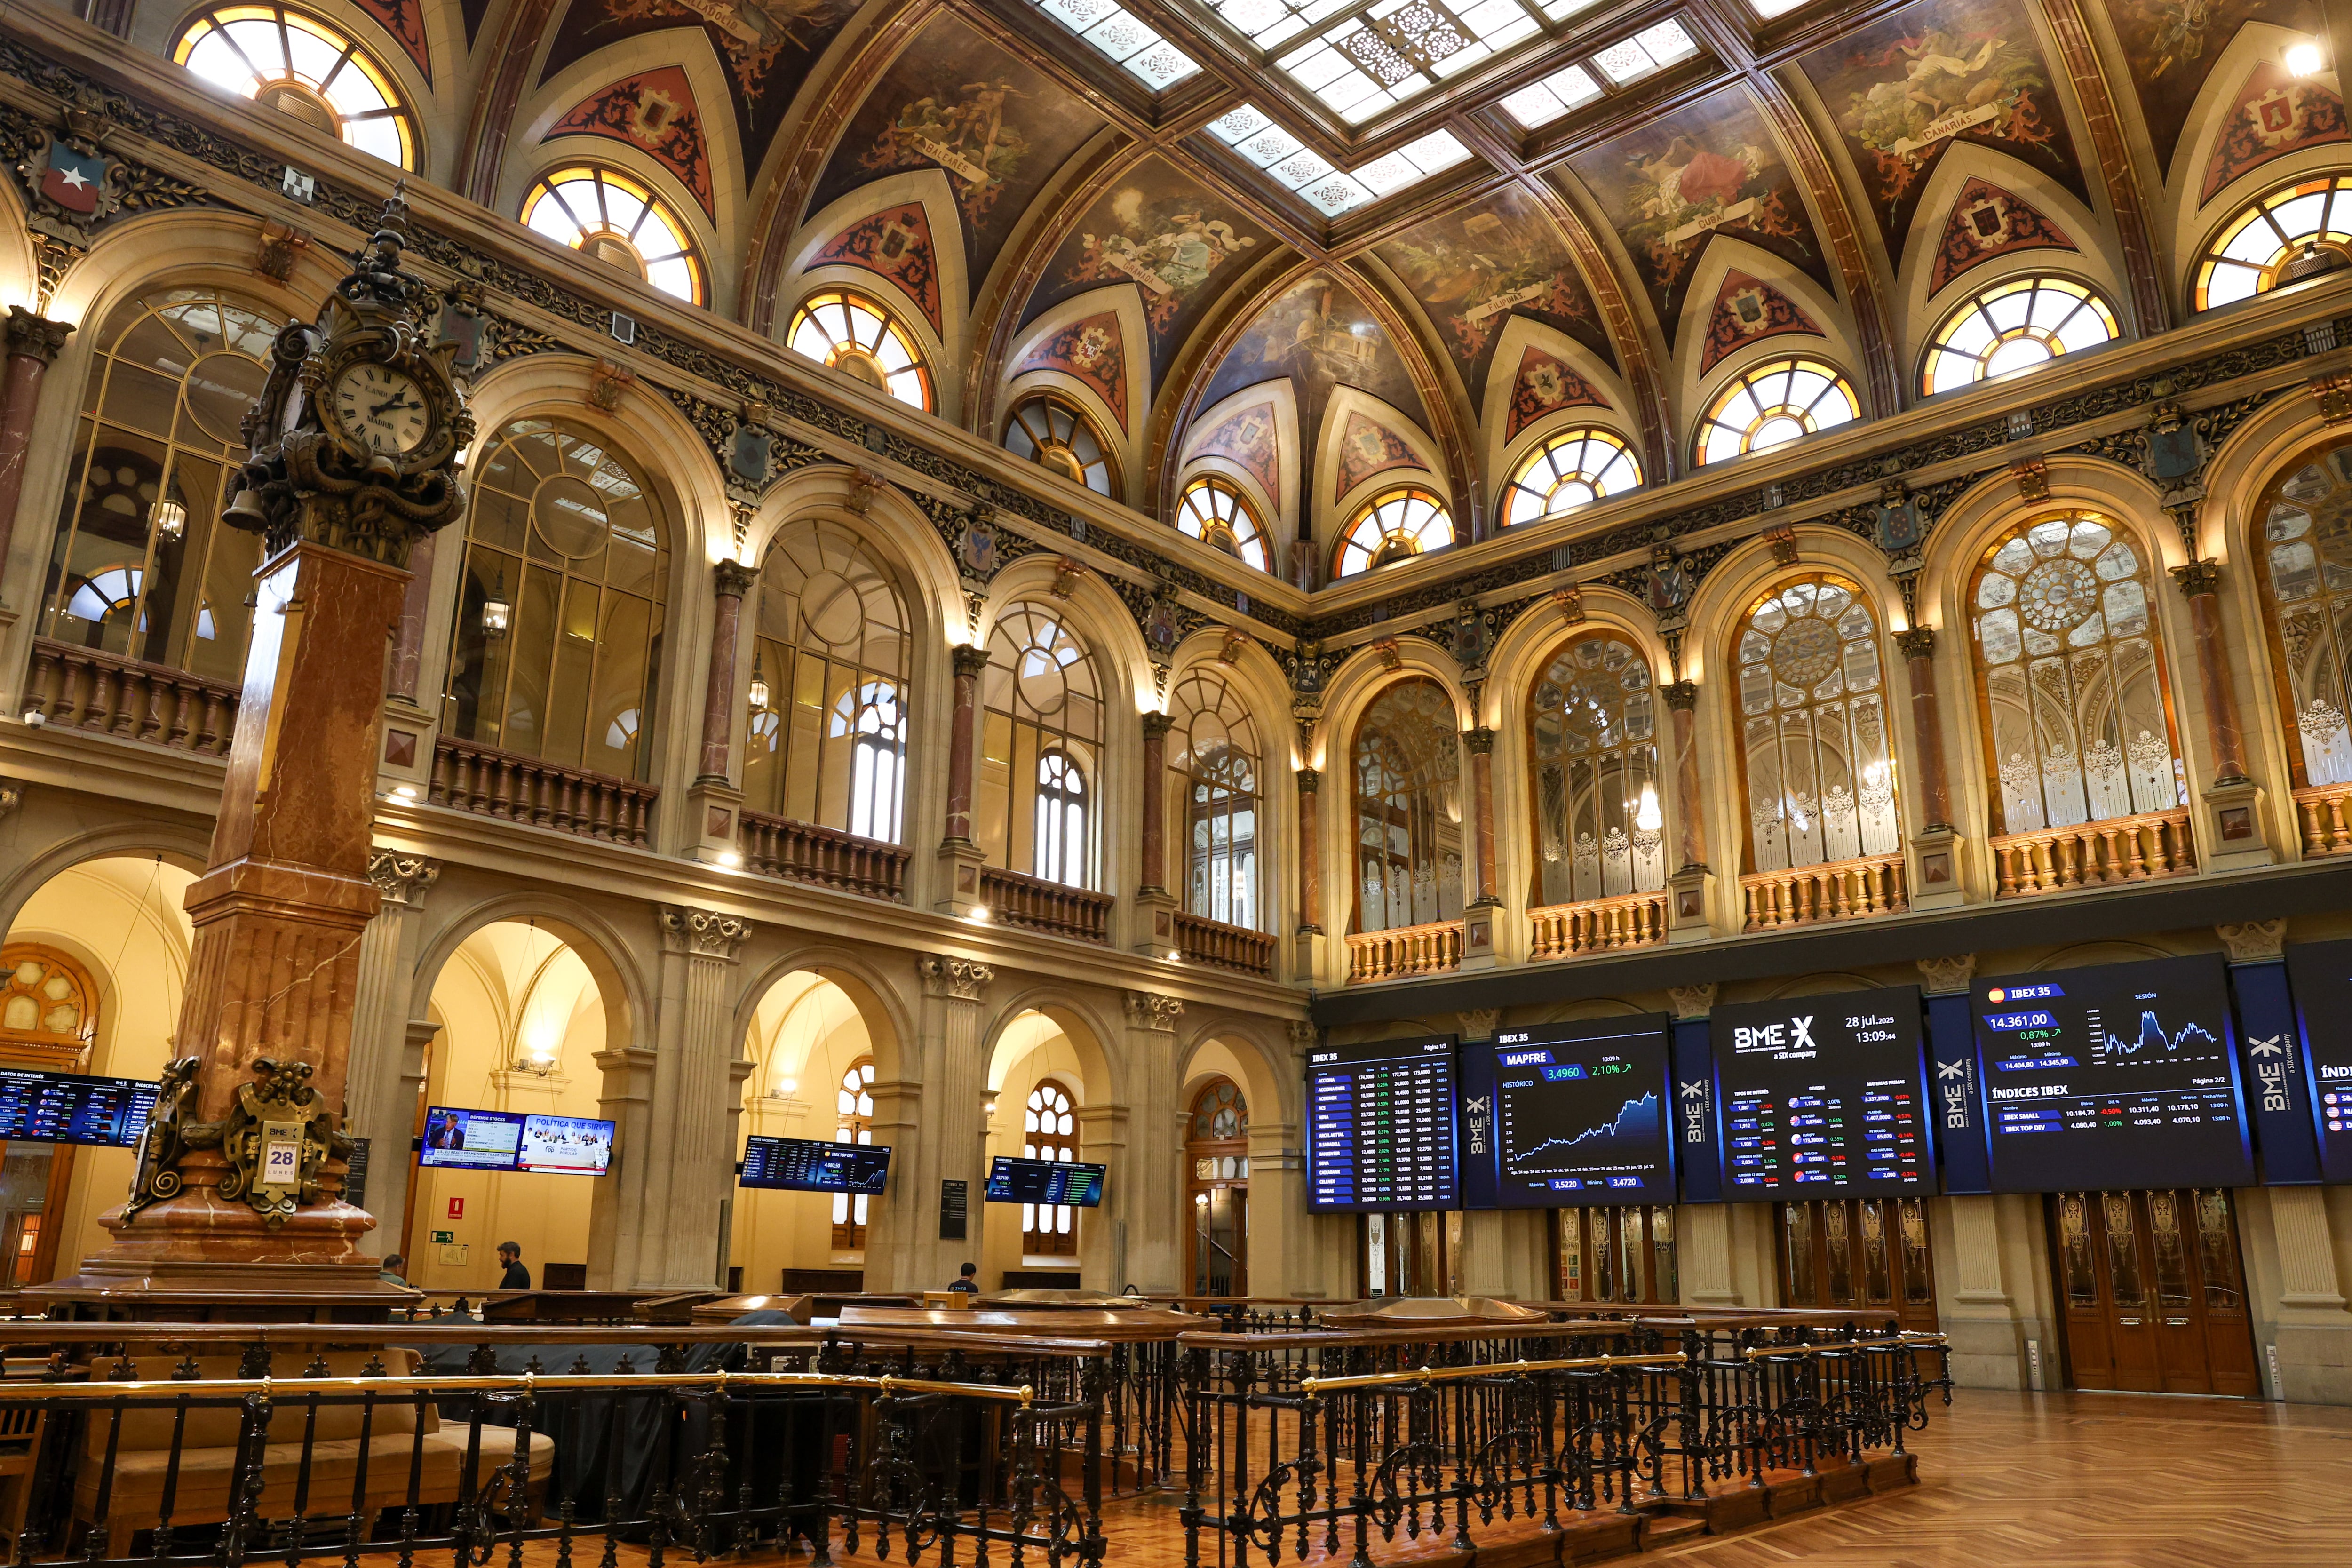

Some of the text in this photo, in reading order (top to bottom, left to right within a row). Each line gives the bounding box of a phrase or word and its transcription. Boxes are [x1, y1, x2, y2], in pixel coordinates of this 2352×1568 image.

[1924, 115, 1976, 140] CANARIAS.
[926, 143, 968, 172] BALEARES
[1123, 262, 1154, 284] GRANADA
[1488, 294, 1526, 311] FILIPINAS.
[366, 415, 394, 430] MADRID
[735, 489, 755, 501] BRASIL
[2166, 490, 2200, 504] HOLANDA
[1893, 559, 1917, 571] JAPON
[2011, 987, 2050, 999] IBEX 35
[1845, 1017, 1859, 1027] 28
[1991, 1014, 2047, 1028] 14.361,00
[1499, 1033, 1528, 1043] IBEX 35
[1734, 1024, 1786, 1049] BME
[1856, 1030, 1896, 1043] 13:09:44
[2020, 1030, 2049, 1041] 0,87%
[2283, 1034, 2292, 1059] company
[1507, 1052, 1546, 1065] MAPFRE
[1789, 1051, 1817, 1059] company
[1548, 1067, 1579, 1079] 3,4960
[1592, 1065, 1620, 1076] 2,10%
[1502, 1080, 1534, 1089] HISTÓRICO
[2258, 1062, 2286, 1111] BME
[1992, 1085, 2068, 1099] ÍNDICES IBEX
[1944, 1084, 1965, 1129] BME
[536, 1118, 569, 1128] POLÍTICA
[1686, 1103, 1702, 1143] BME
[1470, 1117, 1483, 1154] BME
[270, 1151, 293, 1165] 28
